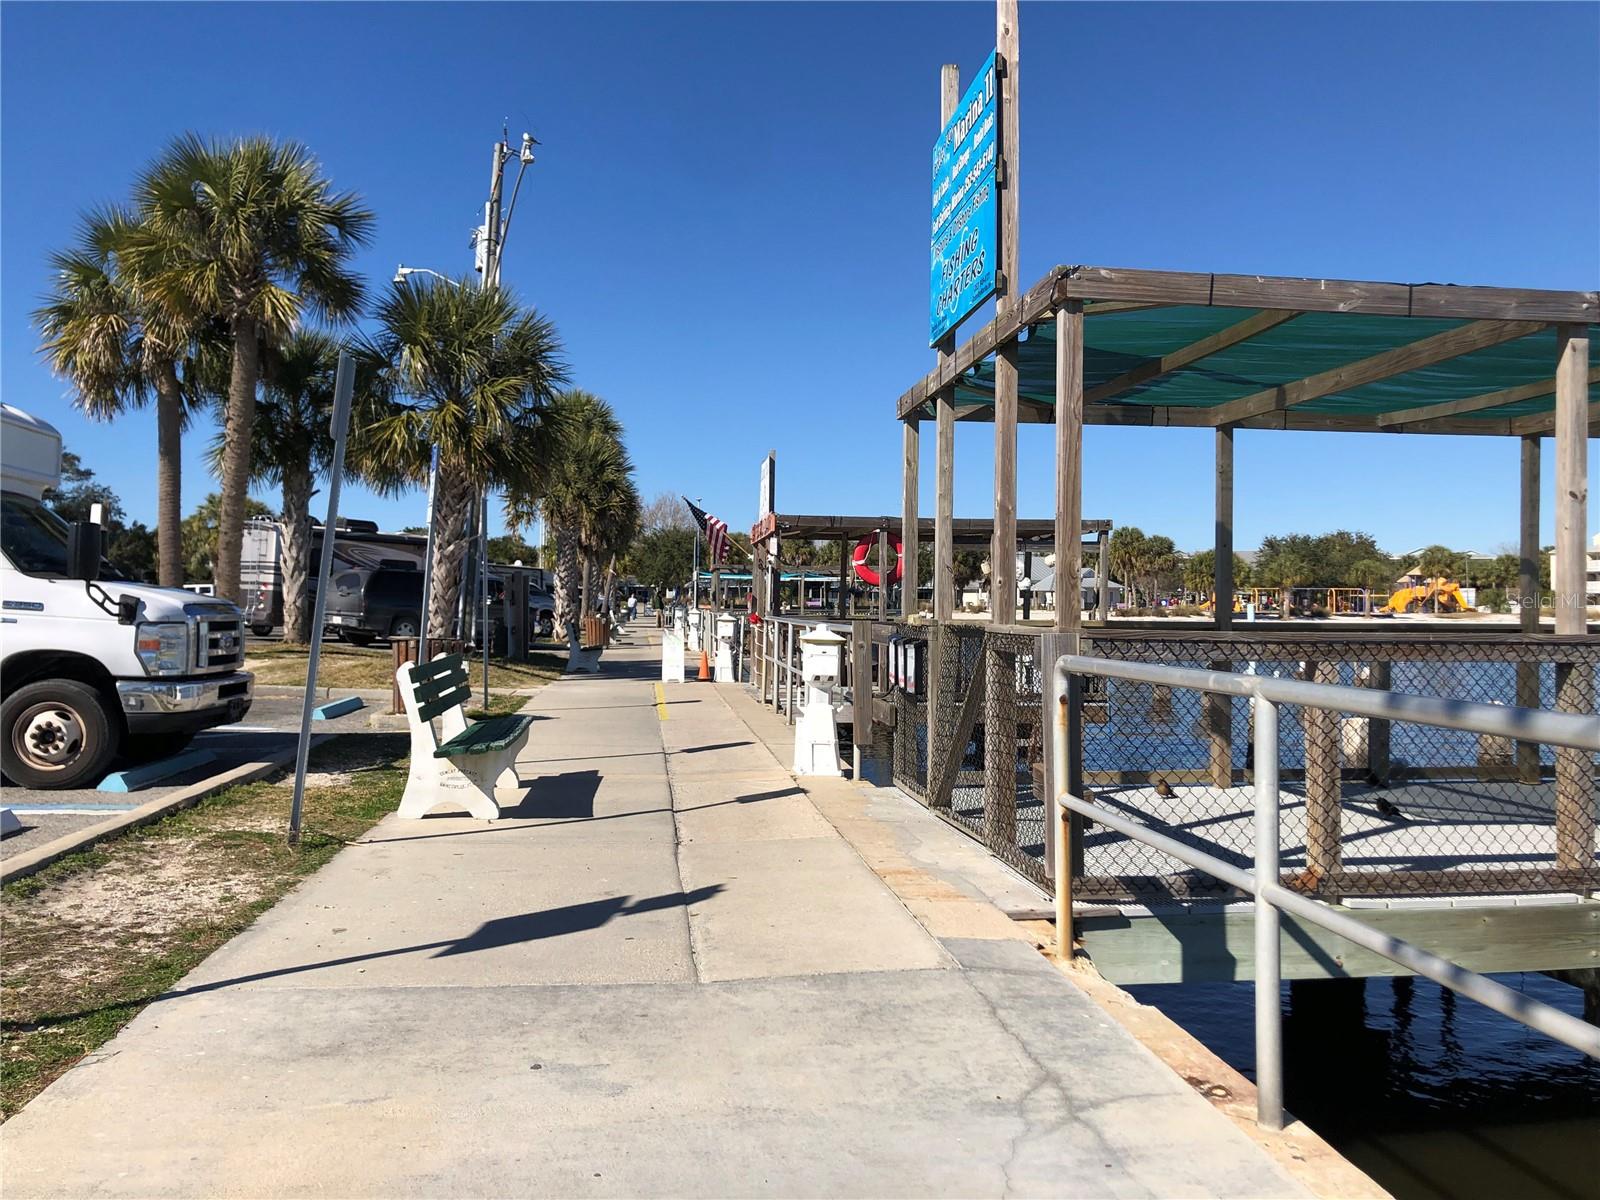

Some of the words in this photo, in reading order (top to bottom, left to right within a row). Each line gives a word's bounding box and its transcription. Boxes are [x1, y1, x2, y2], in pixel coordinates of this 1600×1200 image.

[953, 90, 983, 152] Marina
[936, 250, 985, 317] CHARTERS
[941, 228, 978, 283] FISHING
